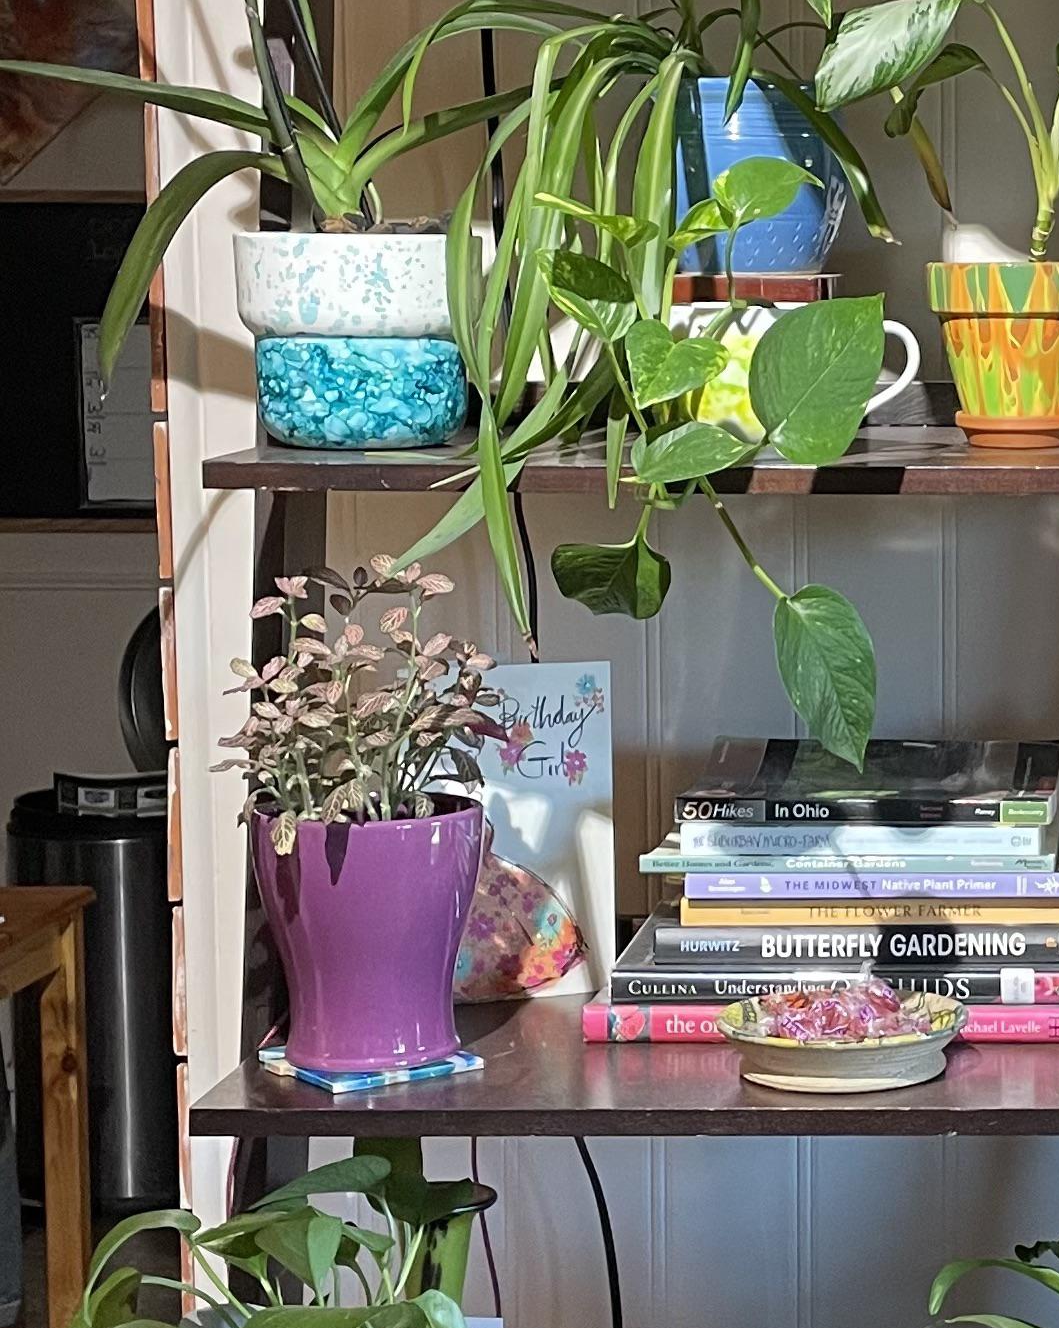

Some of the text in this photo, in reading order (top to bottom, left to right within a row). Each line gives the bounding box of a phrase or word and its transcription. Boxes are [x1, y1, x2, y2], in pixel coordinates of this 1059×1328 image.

[498, 694, 598, 748] Birthday
[516, 740, 567, 779] Girl
[682, 801, 830, 820] 50 Hikes In Ohio
[784, 878, 997, 891] THE MIDWEST Native Plant Primer
[808, 904, 982, 919] THE FLOWER FARMER
[680, 940, 740, 952] HURWITZ
[761, 931, 1026, 959] BUTTERFLY GARDENING
[665, 1014, 696, 1034] the
[958, 1021, 998, 1034] ichael
[1001, 1021, 1041, 1034] Lavelle
